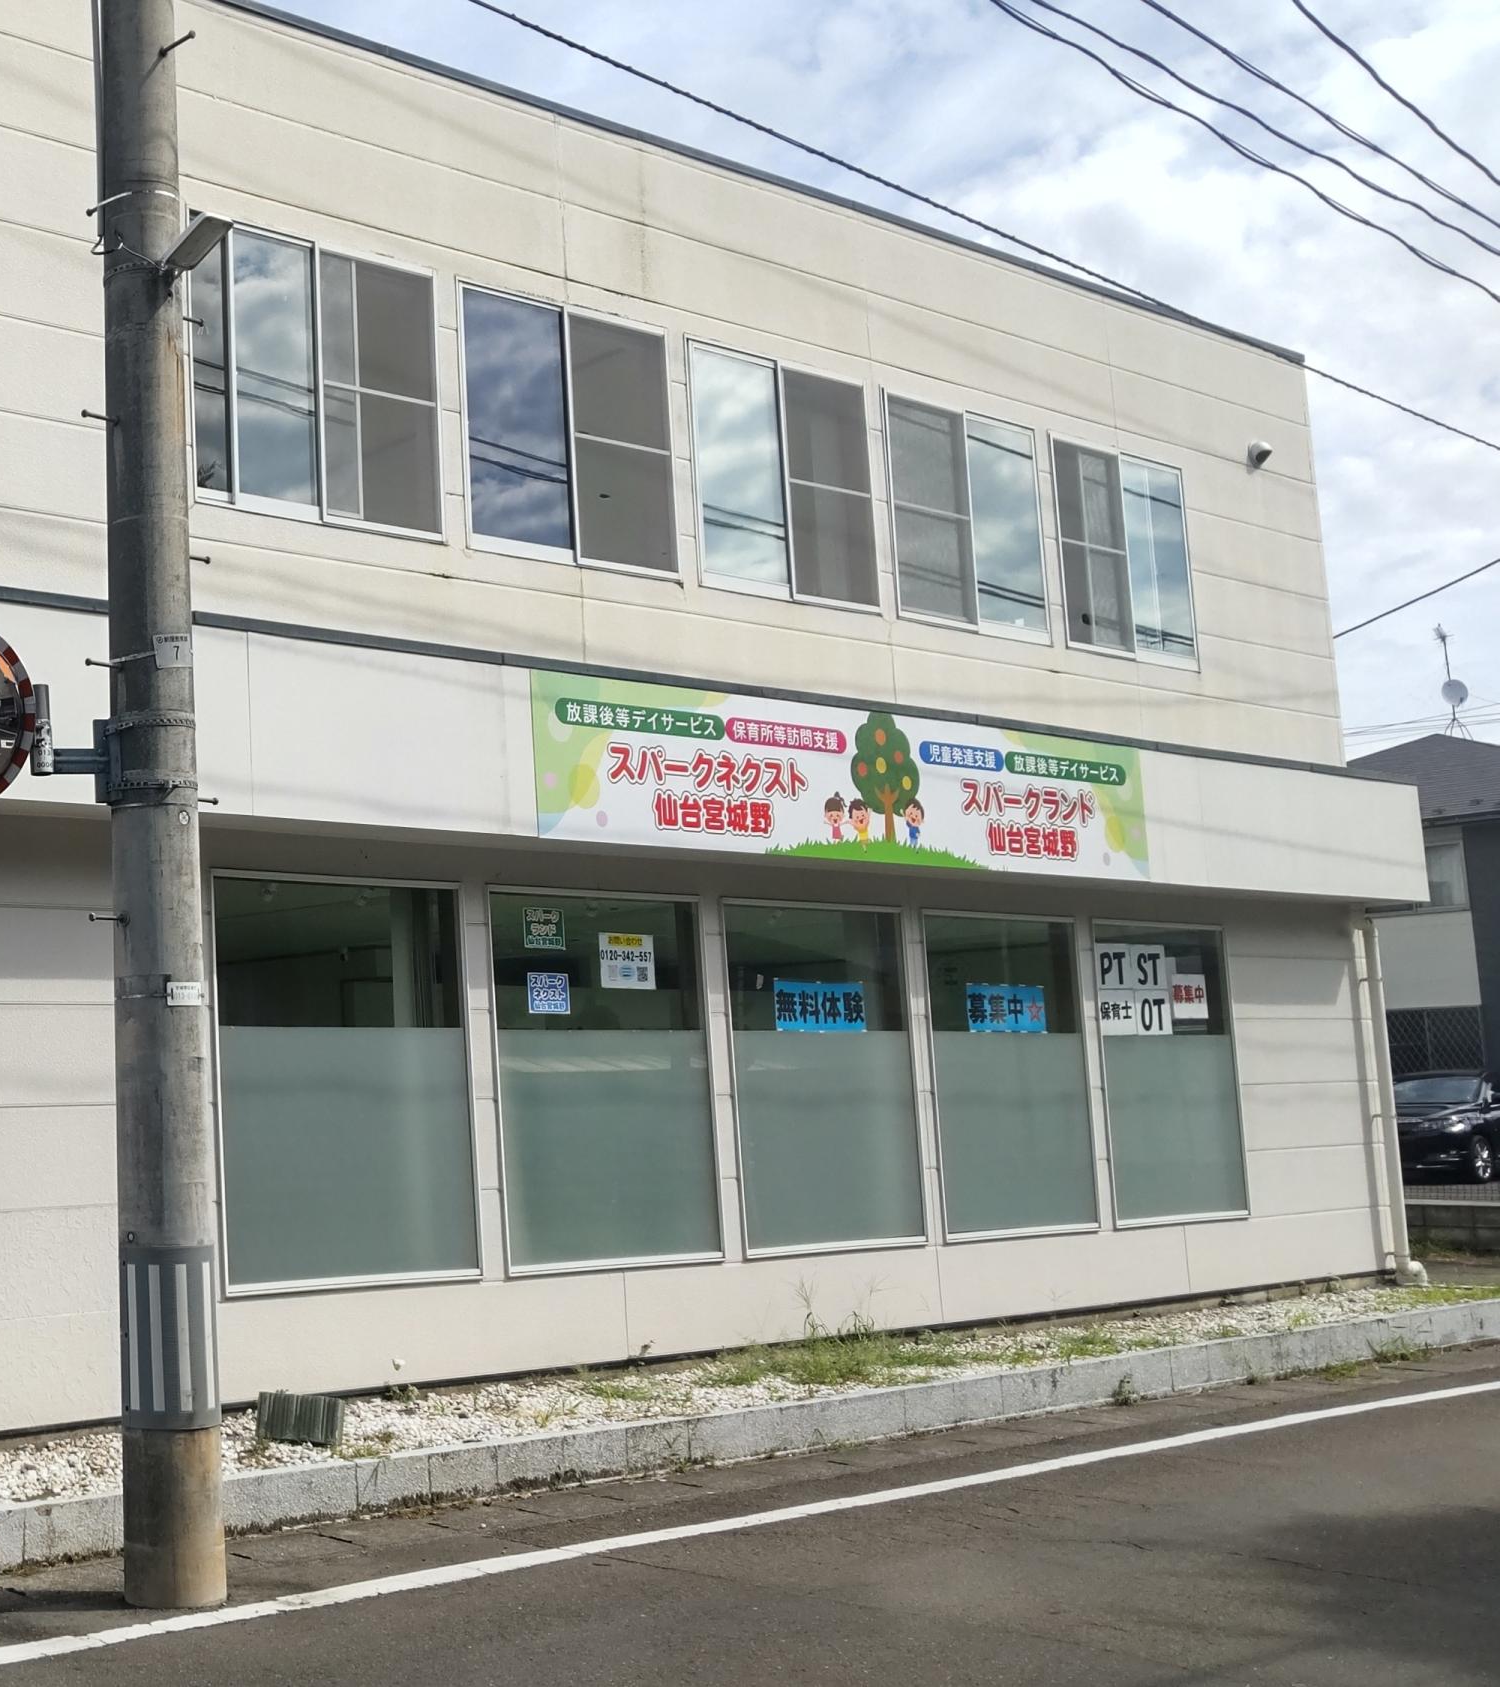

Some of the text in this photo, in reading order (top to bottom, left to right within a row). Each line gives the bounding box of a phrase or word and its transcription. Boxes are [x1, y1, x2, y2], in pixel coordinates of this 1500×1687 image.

[173, 645, 180, 661] 7
[566, 702, 839, 751] 放課後等デイサービス 保育所等訪問支援
[609, 744, 807, 798] スパークネクスト
[930, 744, 1119, 782] 児童発達支援 放課後等デイサービス
[655, 794, 772, 835] 仙台宮城野
[963, 782, 1094, 823] スパークランド
[988, 823, 1077, 859] 仙台宮城野
[601, 950, 651, 962] 0120-342-557
[1101, 952, 1126, 985] PT
[1138, 952, 1160, 985] ST
[533, 989, 565, 1000] ネクスト
[776, 991, 864, 1025] 無料体験
[1100, 1001, 1132, 1020] 保育士
[1173, 985, 1204, 1003] 募集中
[1141, 998, 1165, 1031] OT
